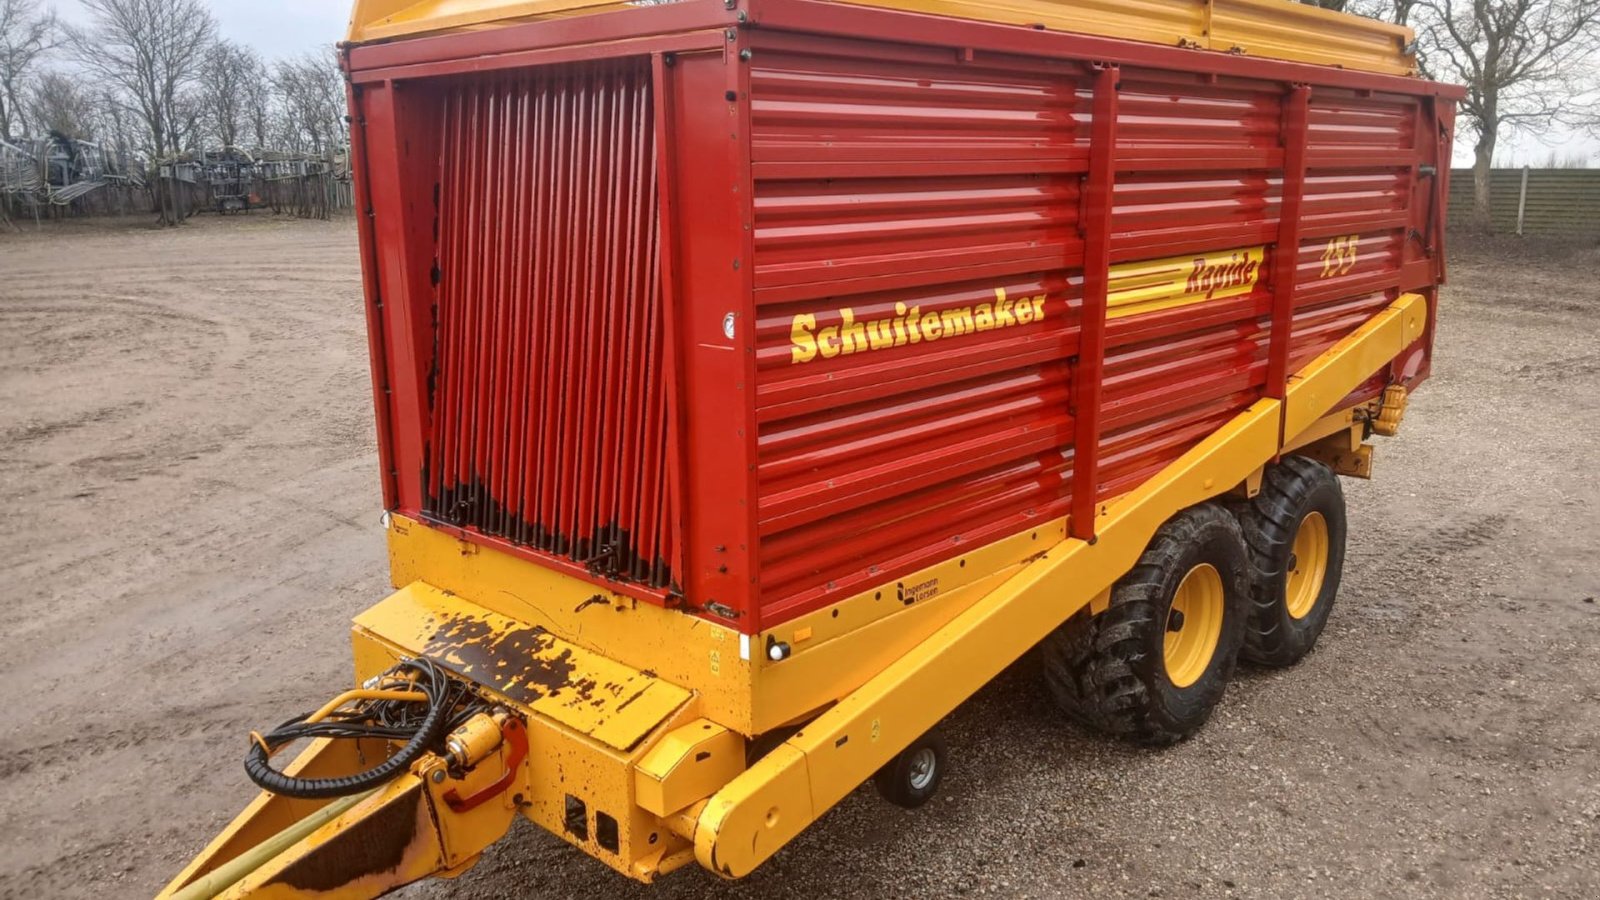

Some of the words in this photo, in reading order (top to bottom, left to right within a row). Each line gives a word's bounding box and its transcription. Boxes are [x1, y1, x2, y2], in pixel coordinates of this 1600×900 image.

[1185, 252, 1257, 298] Rapide
[1320, 235, 1360, 277] 155
[791, 288, 1047, 363] Schuitemaker
